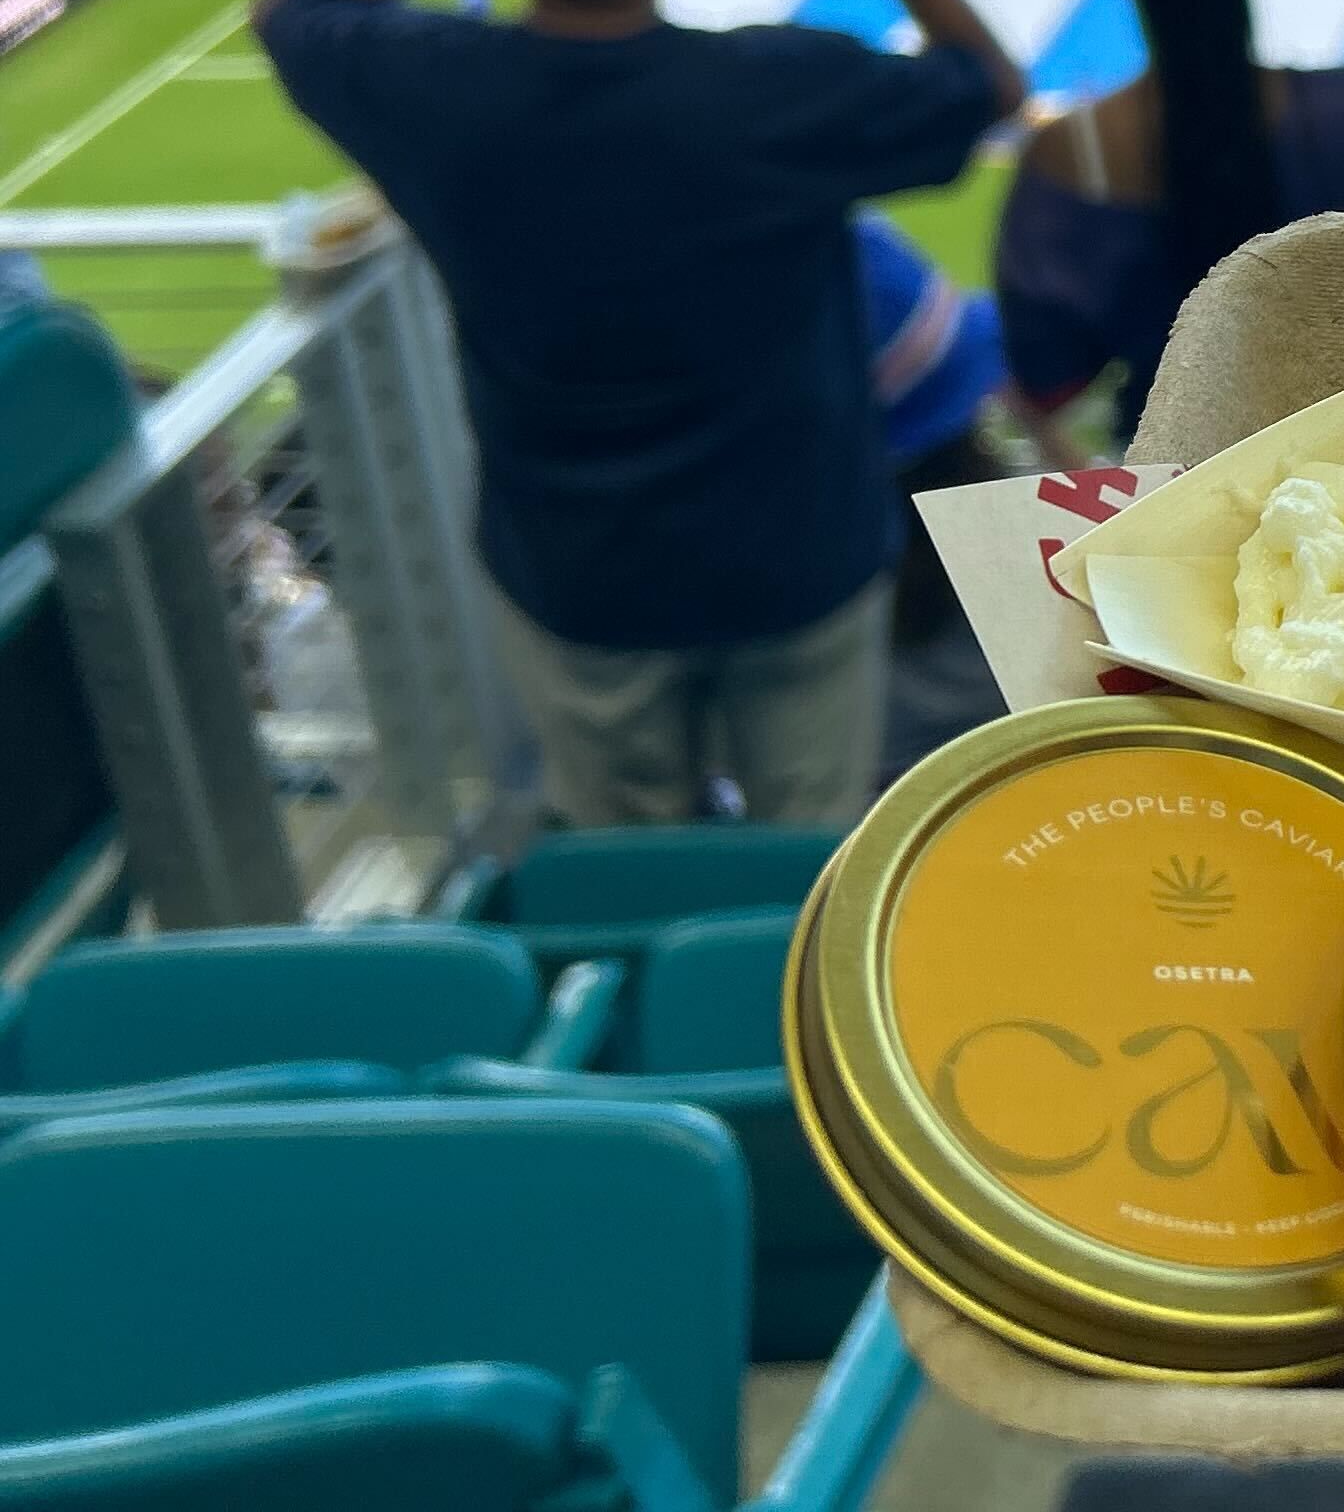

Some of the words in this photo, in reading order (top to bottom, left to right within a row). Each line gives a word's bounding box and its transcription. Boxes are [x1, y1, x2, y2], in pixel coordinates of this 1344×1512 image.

[1003, 823, 1065, 868] THE
[1066, 795, 1228, 831] PEOPLE'S
[1152, 965, 1255, 983] OSETRA
